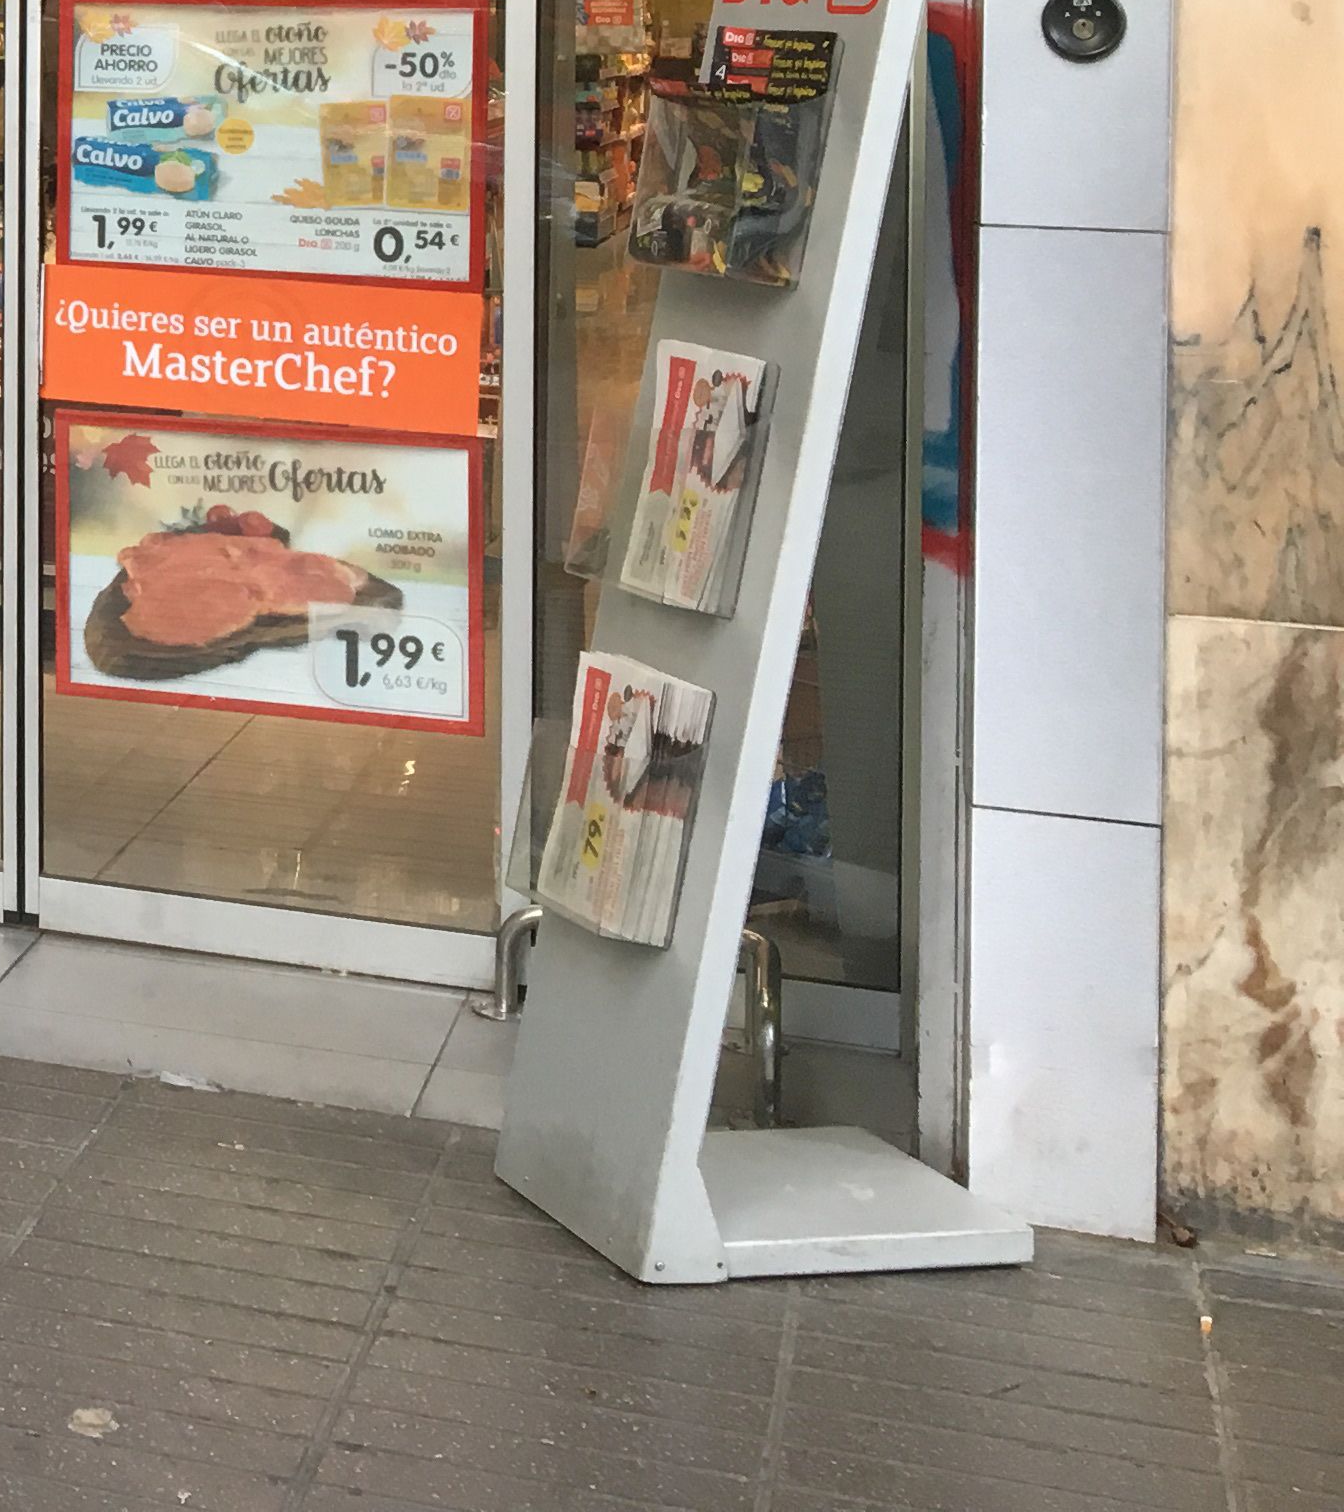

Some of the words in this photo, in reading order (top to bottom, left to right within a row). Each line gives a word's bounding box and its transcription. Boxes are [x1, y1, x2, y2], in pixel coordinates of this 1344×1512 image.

[100, 43, 152, 57] PRECIO
[264, 48, 329, 65] MEJORES
[94, 59, 158, 72] AHORRO
[214, 63, 331, 103] Ofertas
[113, 107, 174, 128] Calvo
[76, 143, 144, 171] Calvo
[185, 209, 210, 219] ATÚN
[213, 211, 243, 220] CLARO
[290, 215, 322, 224] QUESO
[324, 216, 360, 225] GOUDA
[149, 221, 158, 233] €
[315, 229, 360, 238] LONCHAS
[450, 234, 460, 246] €
[185, 246, 216, 254] LIGERO
[219, 247, 258, 256] GIRASOL
[55, 299, 184, 335] ¿Quieres
[194, 316, 241, 339] ser
[251, 320, 293, 343] un
[304, 322, 458, 356] auténtico
[122, 341, 397, 398] MasterChef?
[154, 456, 187, 469] LLEGA
[203, 451, 266, 470] otoño
[268, 461, 387, 502] Ofertas
[368, 528, 403, 541] LOMO
[407, 530, 443, 543] EXTRA
[375, 543, 436, 557] ADOBADO
[431, 642, 445, 662] €
[416, 677, 447, 694] €/kg
